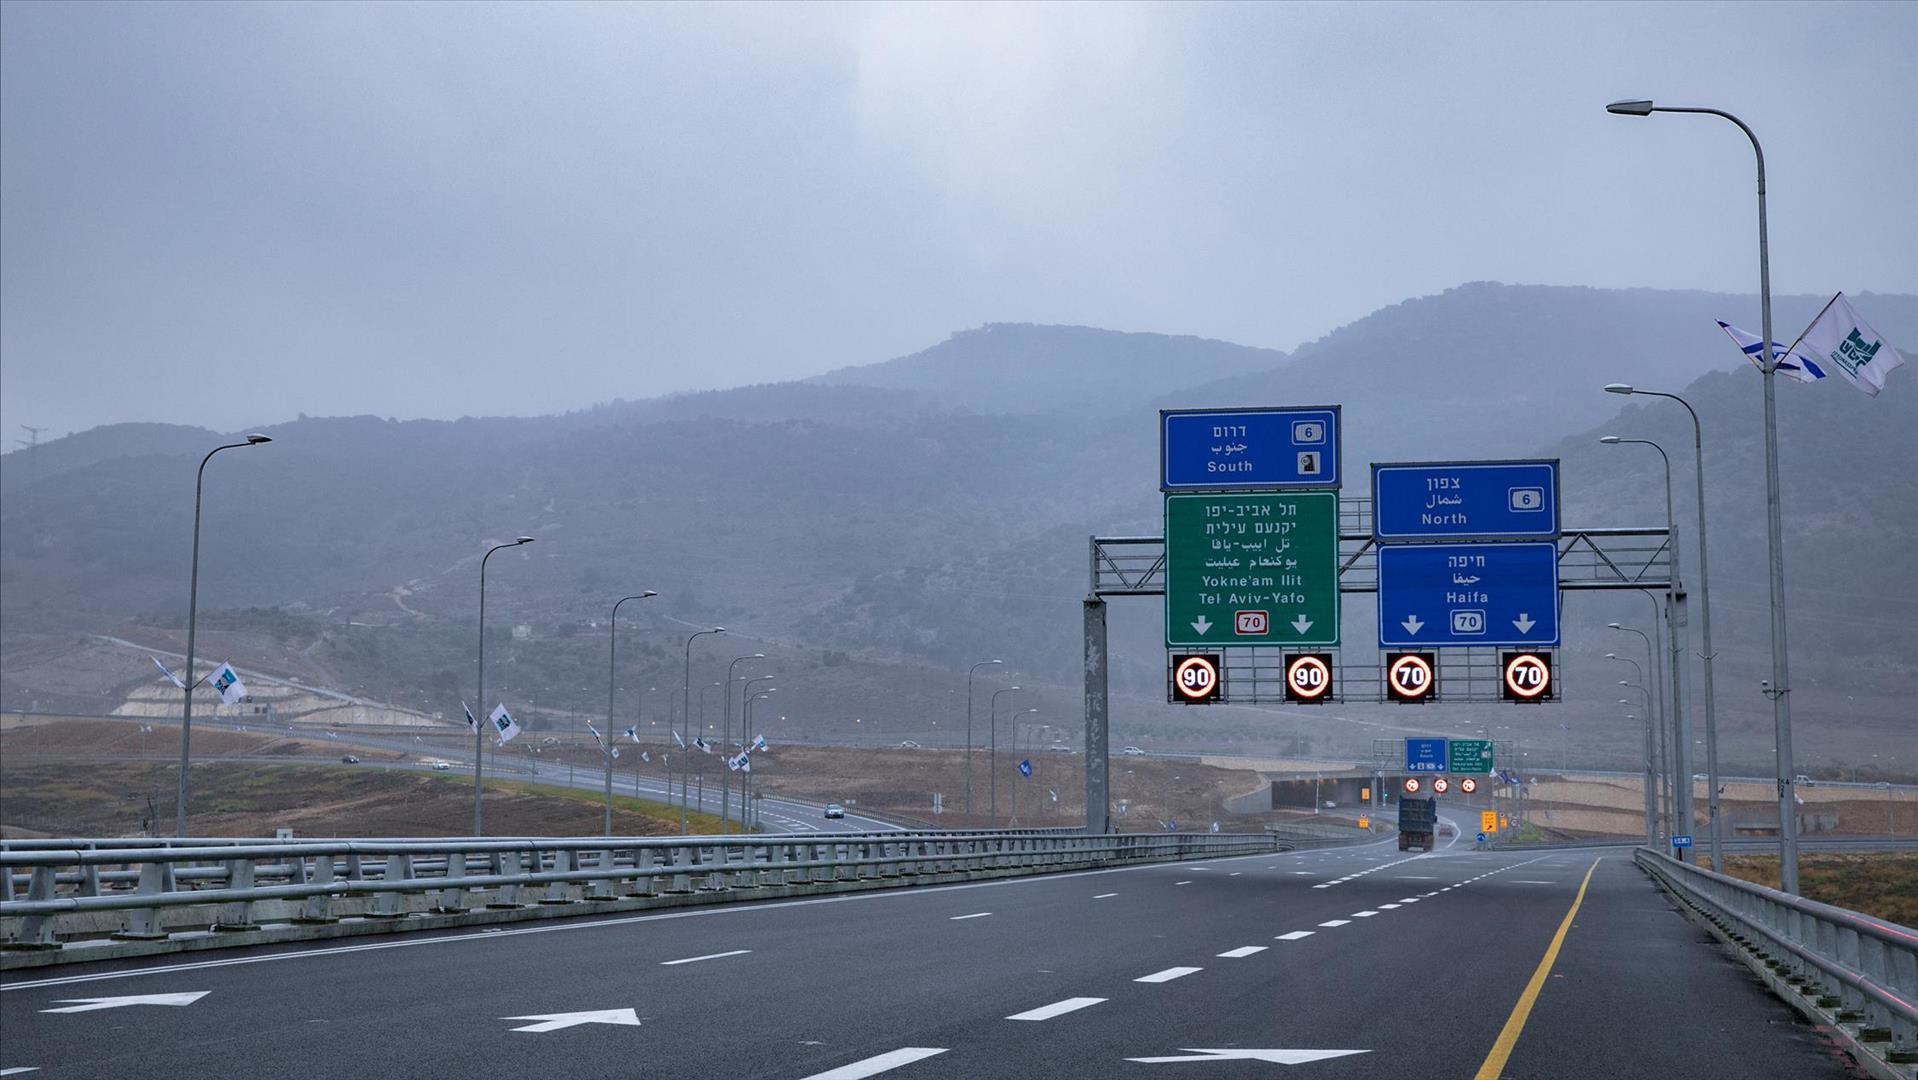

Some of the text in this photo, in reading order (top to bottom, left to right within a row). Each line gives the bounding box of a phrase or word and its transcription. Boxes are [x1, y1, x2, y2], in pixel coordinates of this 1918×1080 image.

[1213, 425, 1246, 438] דרום
[1305, 427, 1312, 438] 6
[1211, 442, 1248, 456] جنوب
[1207, 460, 1253, 473] South
[1426, 477, 1461, 492] צפון
[1425, 494, 1463, 509] شمال
[1523, 494, 1530, 504] 6
[1205, 502, 1297, 517] תל אביב-יפו
[1422, 512, 1467, 525] North
[1206, 521, 1296, 535] יקנעם עילית
[1275, 538, 1290, 554] تل
[1448, 555, 1485, 568] חיפה
[1201, 574, 1302, 587] Yokne'am Ilit
[1453, 572, 1481, 586] حيفا
[1198, 592, 1305, 605] Tel Aviv-Yafo
[1446, 591, 1488, 604] Haifa
[1243, 617, 1260, 627] 70
[1460, 617, 1476, 627] 70
[1183, 668, 1209, 686] 90
[1295, 667, 1322, 686] 90
[1398, 666, 1425, 685] 70
[1515, 666, 1541, 685] 70
